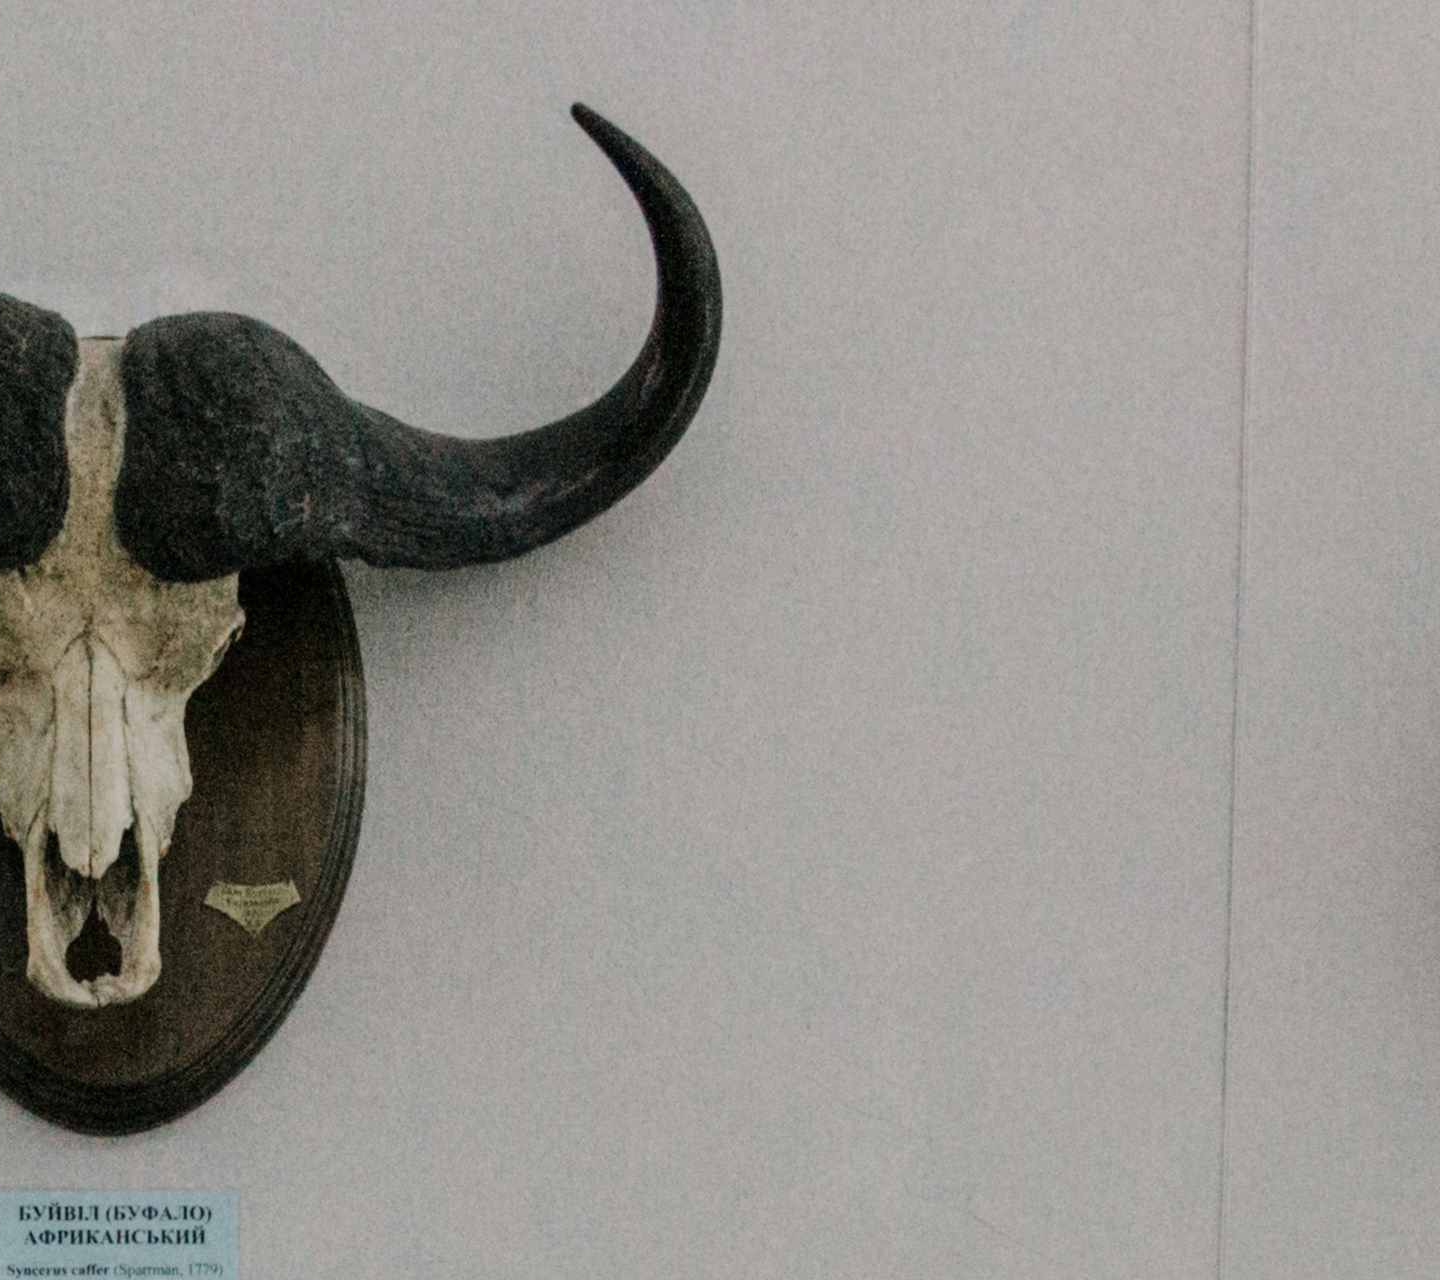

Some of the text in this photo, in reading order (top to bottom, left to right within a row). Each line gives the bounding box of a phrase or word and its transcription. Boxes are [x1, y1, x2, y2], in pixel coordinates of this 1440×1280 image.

[19, 1202, 212, 1224] БУЙВІЛ (БУФАЛО)
[24, 1226, 206, 1245] АФРИКАНСЬКИЙ
[6, 1264, 223, 1278] Syncerus caffer (Sparrman, 1779)
